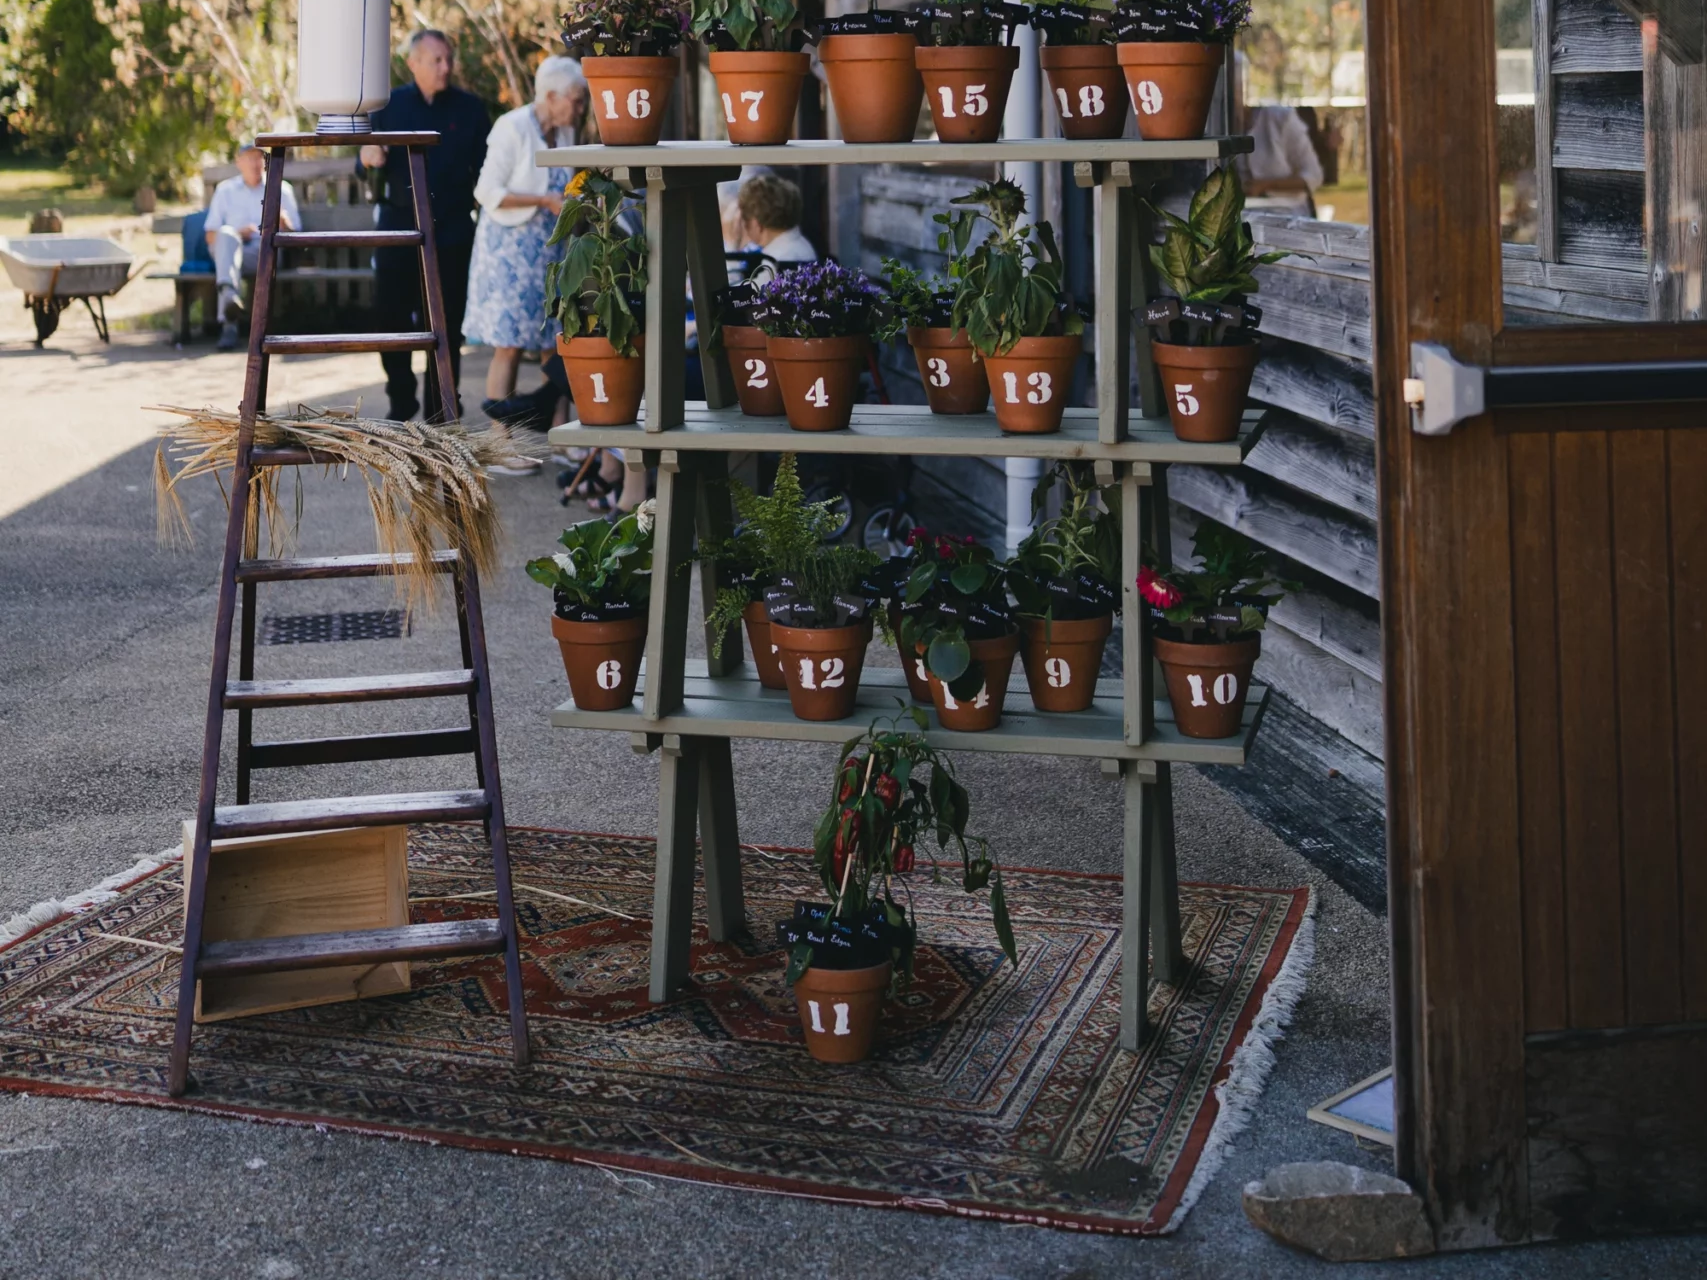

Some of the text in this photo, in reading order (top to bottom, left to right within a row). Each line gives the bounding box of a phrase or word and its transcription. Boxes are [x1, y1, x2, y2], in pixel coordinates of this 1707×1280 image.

[601, 89, 651, 120] 16
[721, 90, 764, 123] 17
[938, 84, 988, 118] 15
[1057, 85, 1105, 118] 18
[589, 372, 609, 403] 1
[744, 359, 769, 389] 2
[927, 358, 951, 387] 3
[1002, 371, 1052, 404] 13
[804, 377, 829, 408] 4
[1174, 383, 1200, 416] 5
[596, 659, 622, 690] 6
[799, 657, 845, 690] 12
[1045, 658, 1071, 688] 9
[1186, 673, 1237, 707] 10
[807, 1000, 851, 1036] 11
